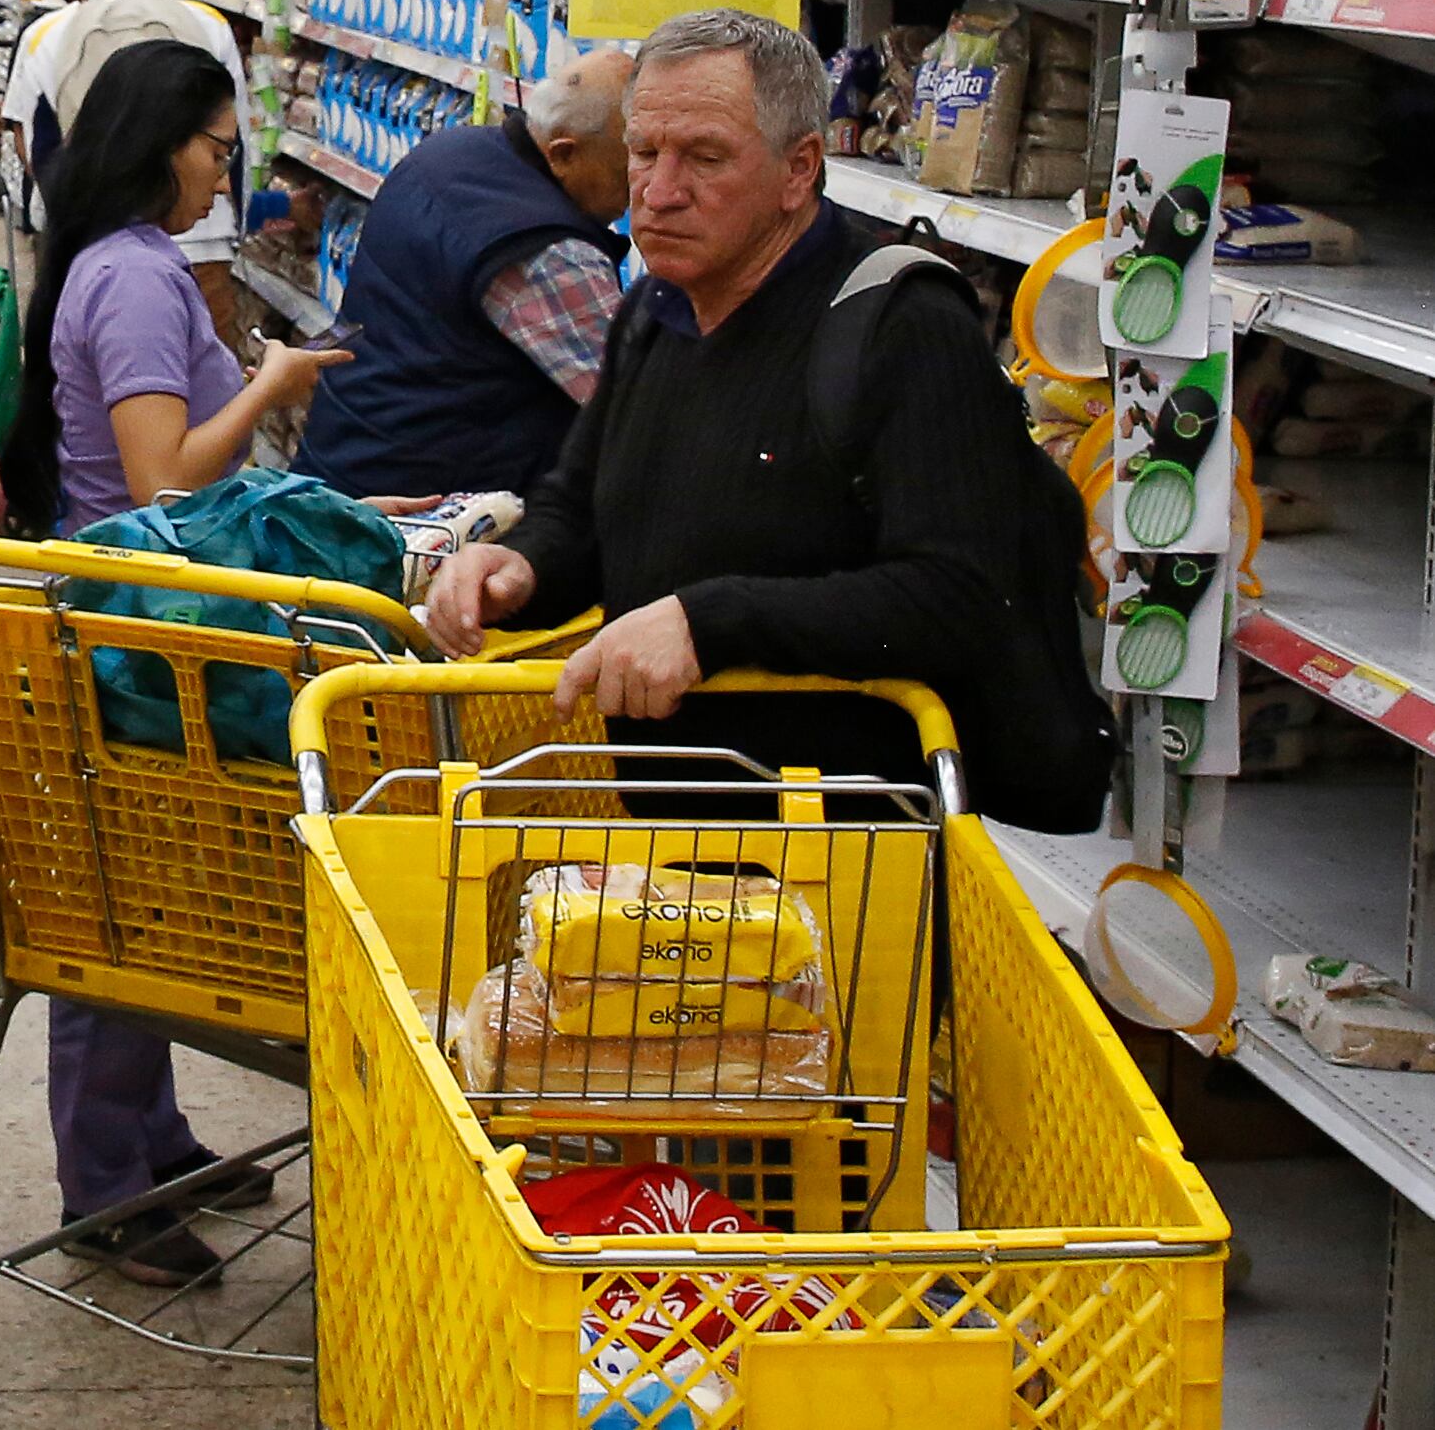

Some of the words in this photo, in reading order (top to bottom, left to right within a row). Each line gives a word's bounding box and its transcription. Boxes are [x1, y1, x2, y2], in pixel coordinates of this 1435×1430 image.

[622, 903, 725, 922] ekono
[640, 941, 713, 963] ekono
[649, 1005, 721, 1025] ekono
